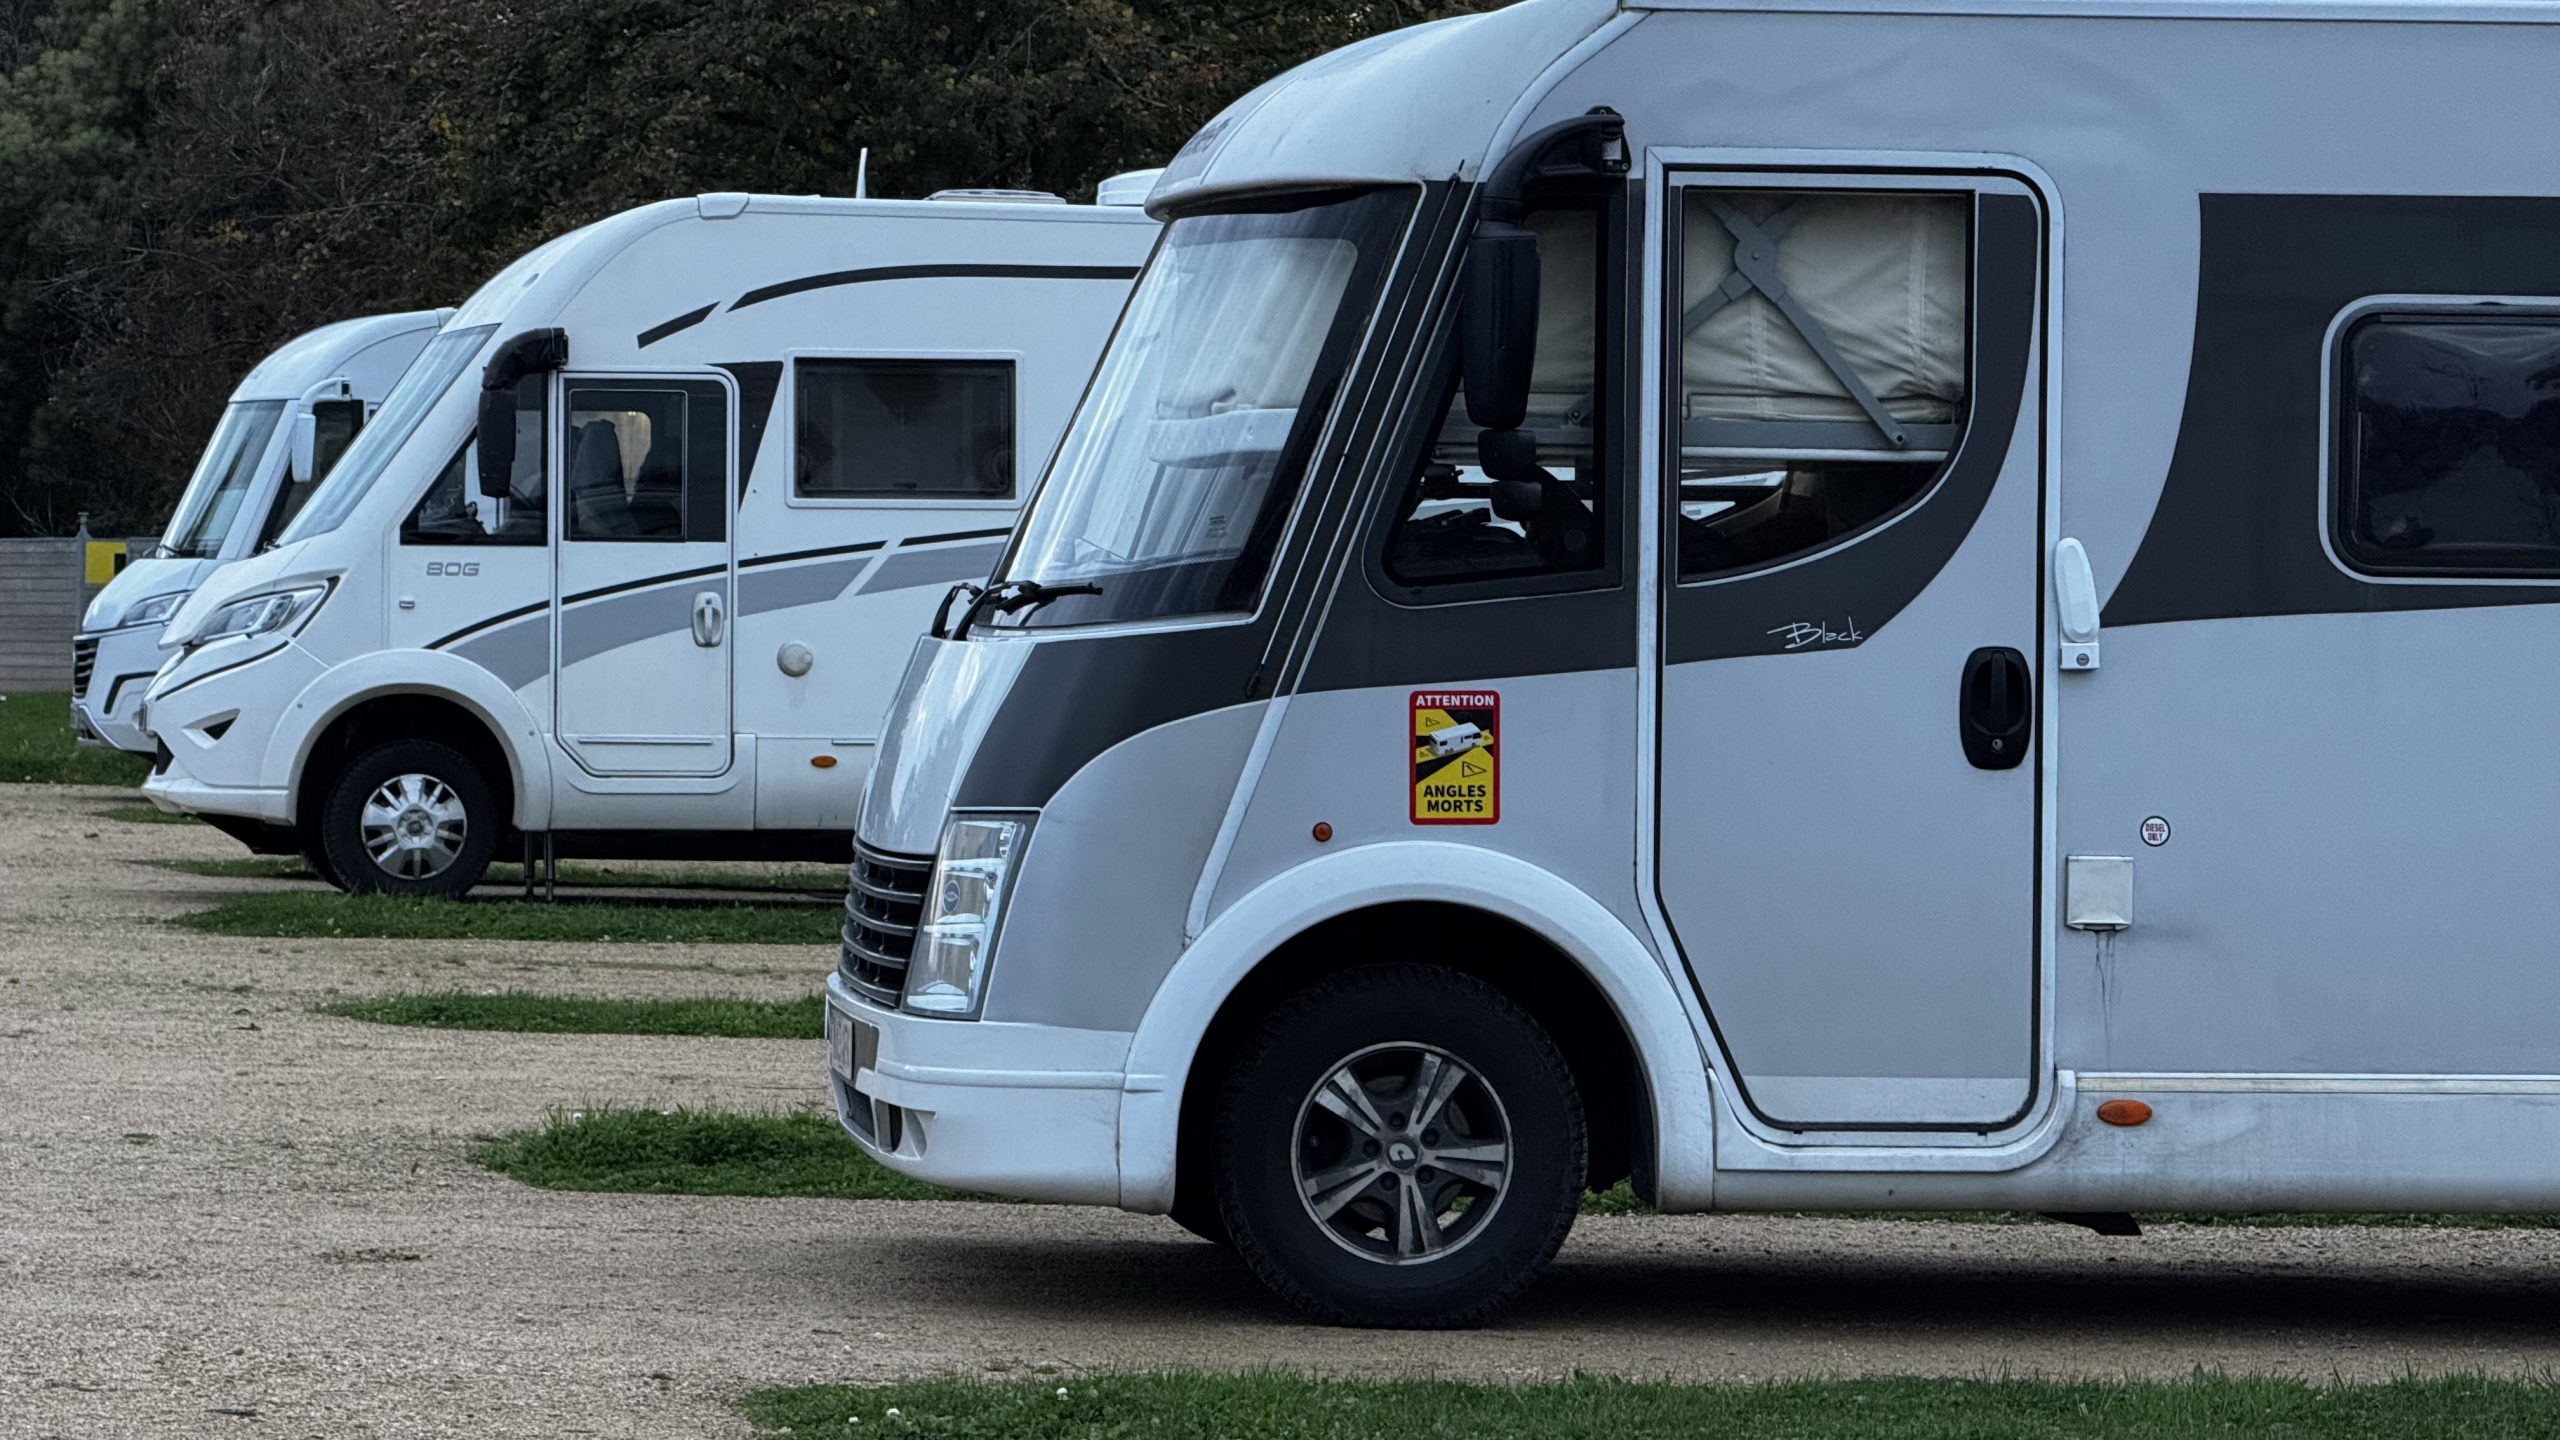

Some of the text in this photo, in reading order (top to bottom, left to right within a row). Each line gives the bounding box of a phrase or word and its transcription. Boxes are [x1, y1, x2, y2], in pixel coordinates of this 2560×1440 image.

[1766, 616, 1863, 648] Black
[1416, 695, 1494, 706] ATTENTION
[1423, 785, 1486, 797] ANGLES
[1427, 800, 1483, 812] MORTS
[2145, 823, 2165, 832] DIESEL
